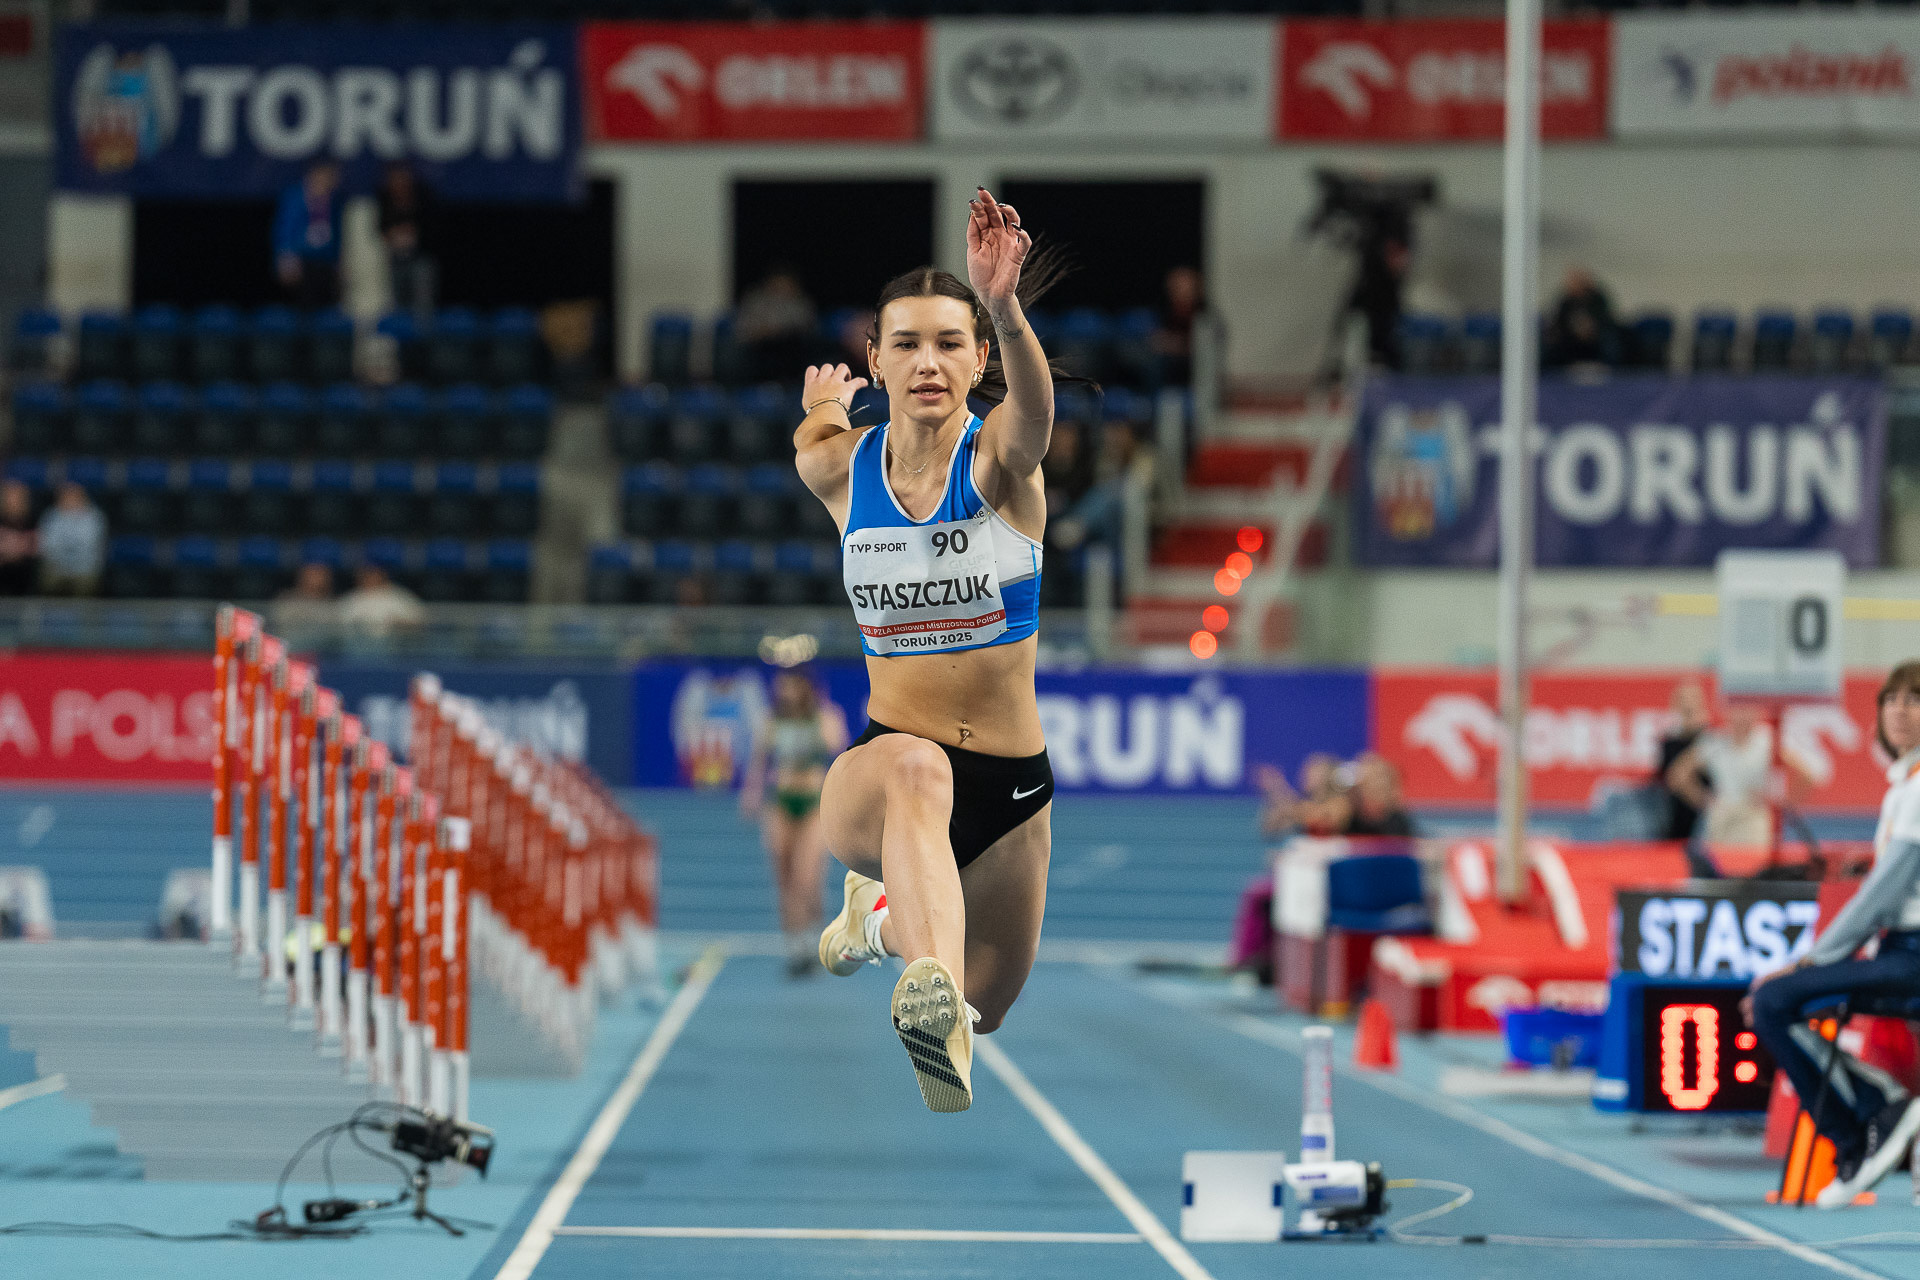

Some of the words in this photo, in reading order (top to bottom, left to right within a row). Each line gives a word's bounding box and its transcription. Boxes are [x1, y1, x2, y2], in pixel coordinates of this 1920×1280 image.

[183, 40, 565, 160] TORUŃ
[850, 544, 872, 553] TVP
[874, 542, 908, 553] SPORT
[931, 529, 969, 557] 90
[852, 574, 994, 610] STASZCZUK
[873, 627, 892, 636] PZLA
[894, 624, 925, 633] Halowe
[926, 620, 975, 630] Mistrzostwa
[976, 612, 1001, 626] Polski
[1789, 599, 1828, 656] 0
[892, 633, 938, 648] TORUŃ
[940, 632, 973, 645] 2025
